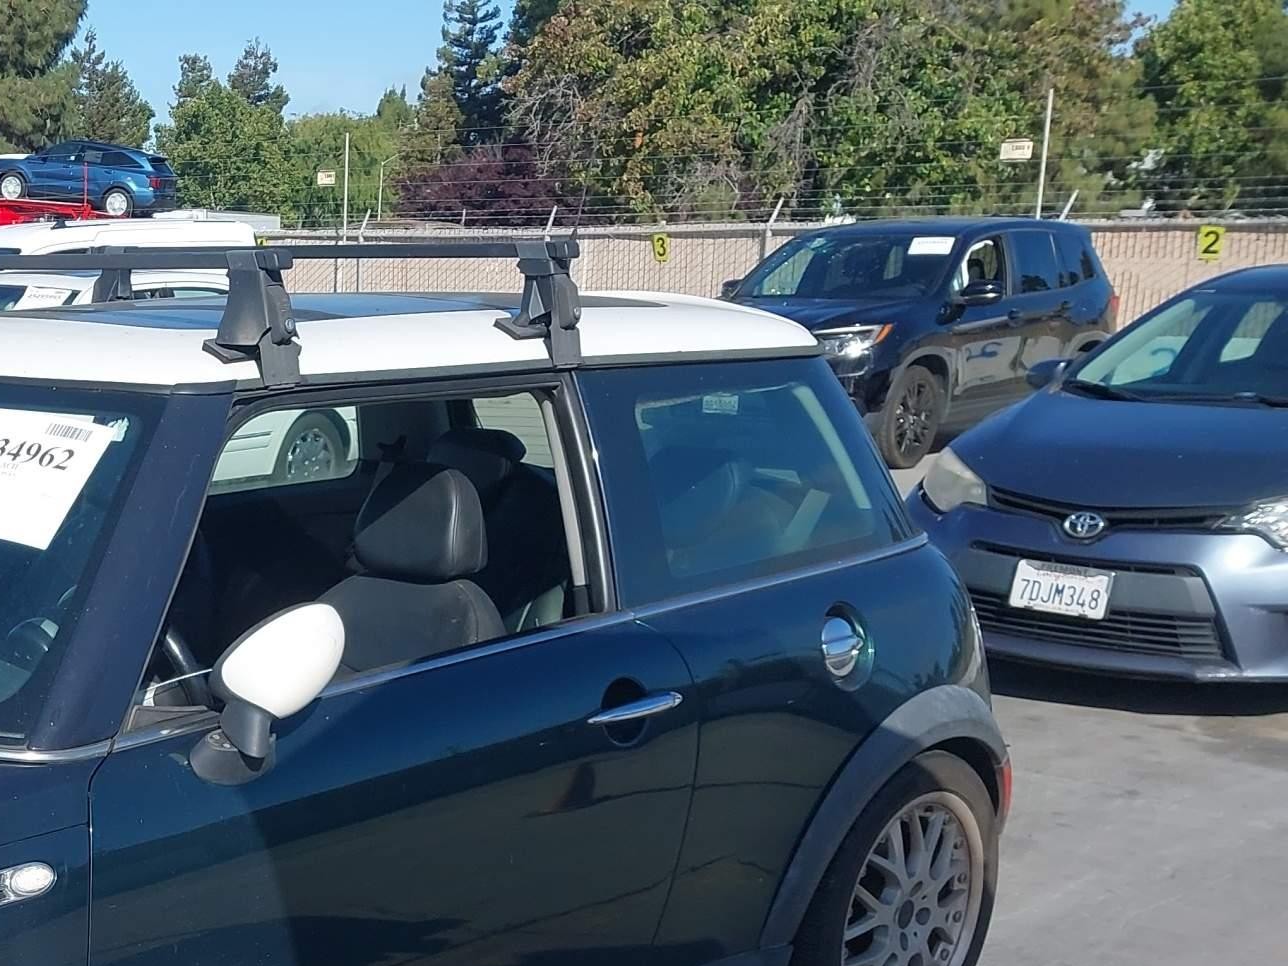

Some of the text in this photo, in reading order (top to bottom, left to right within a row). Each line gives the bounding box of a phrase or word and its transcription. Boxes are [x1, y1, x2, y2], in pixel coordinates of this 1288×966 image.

[655, 236, 667, 257] 3
[1201, 230, 1220, 254] 2
[1019, 578, 1101, 611] 7DJM348
